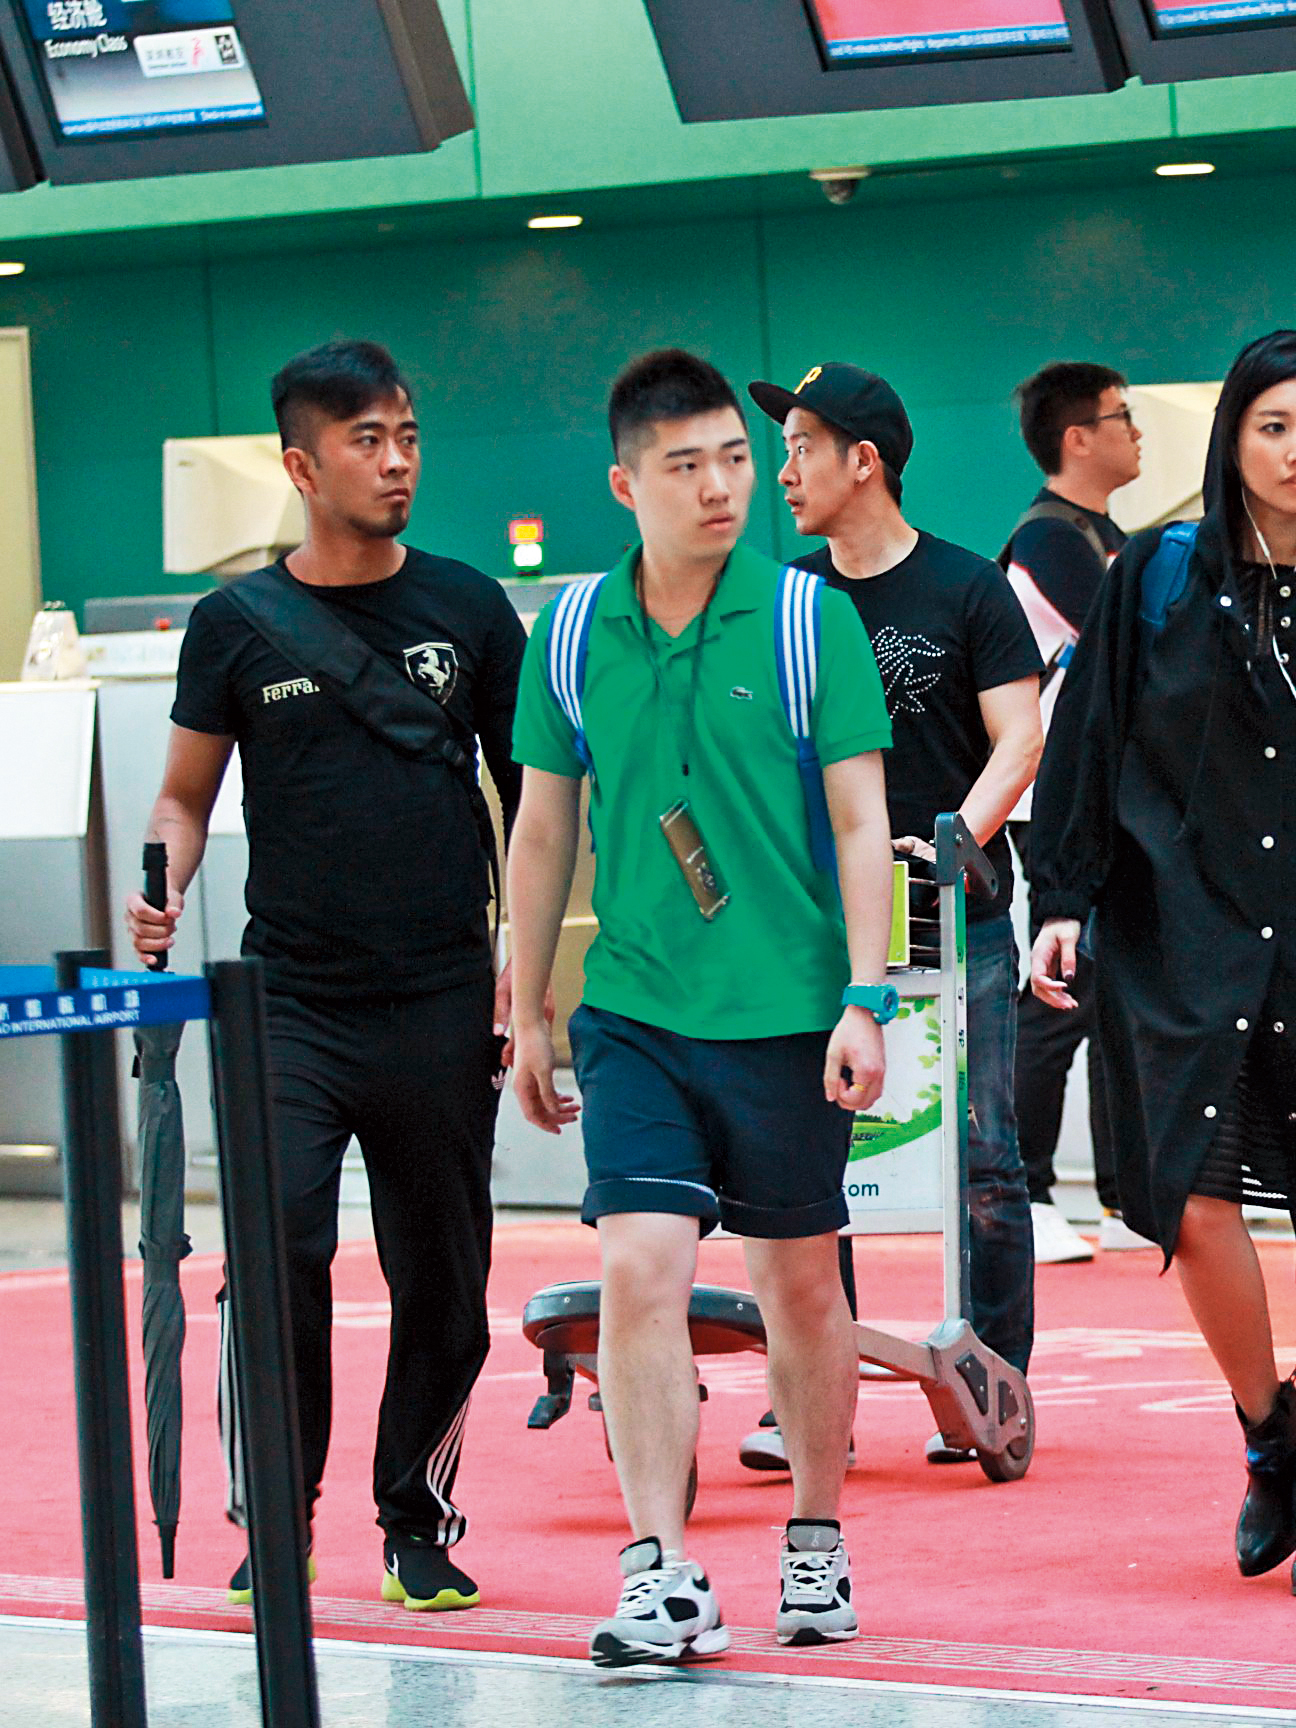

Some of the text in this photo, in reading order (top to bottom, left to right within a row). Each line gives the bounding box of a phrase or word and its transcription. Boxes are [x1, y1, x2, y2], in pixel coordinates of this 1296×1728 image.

[262, 677, 320, 703] Ferra
[11, 1014, 93, 1033] INTERNATIONAL
[94, 1009, 140, 1024] AIRPORT
[842, 1183, 879, 1197] om
